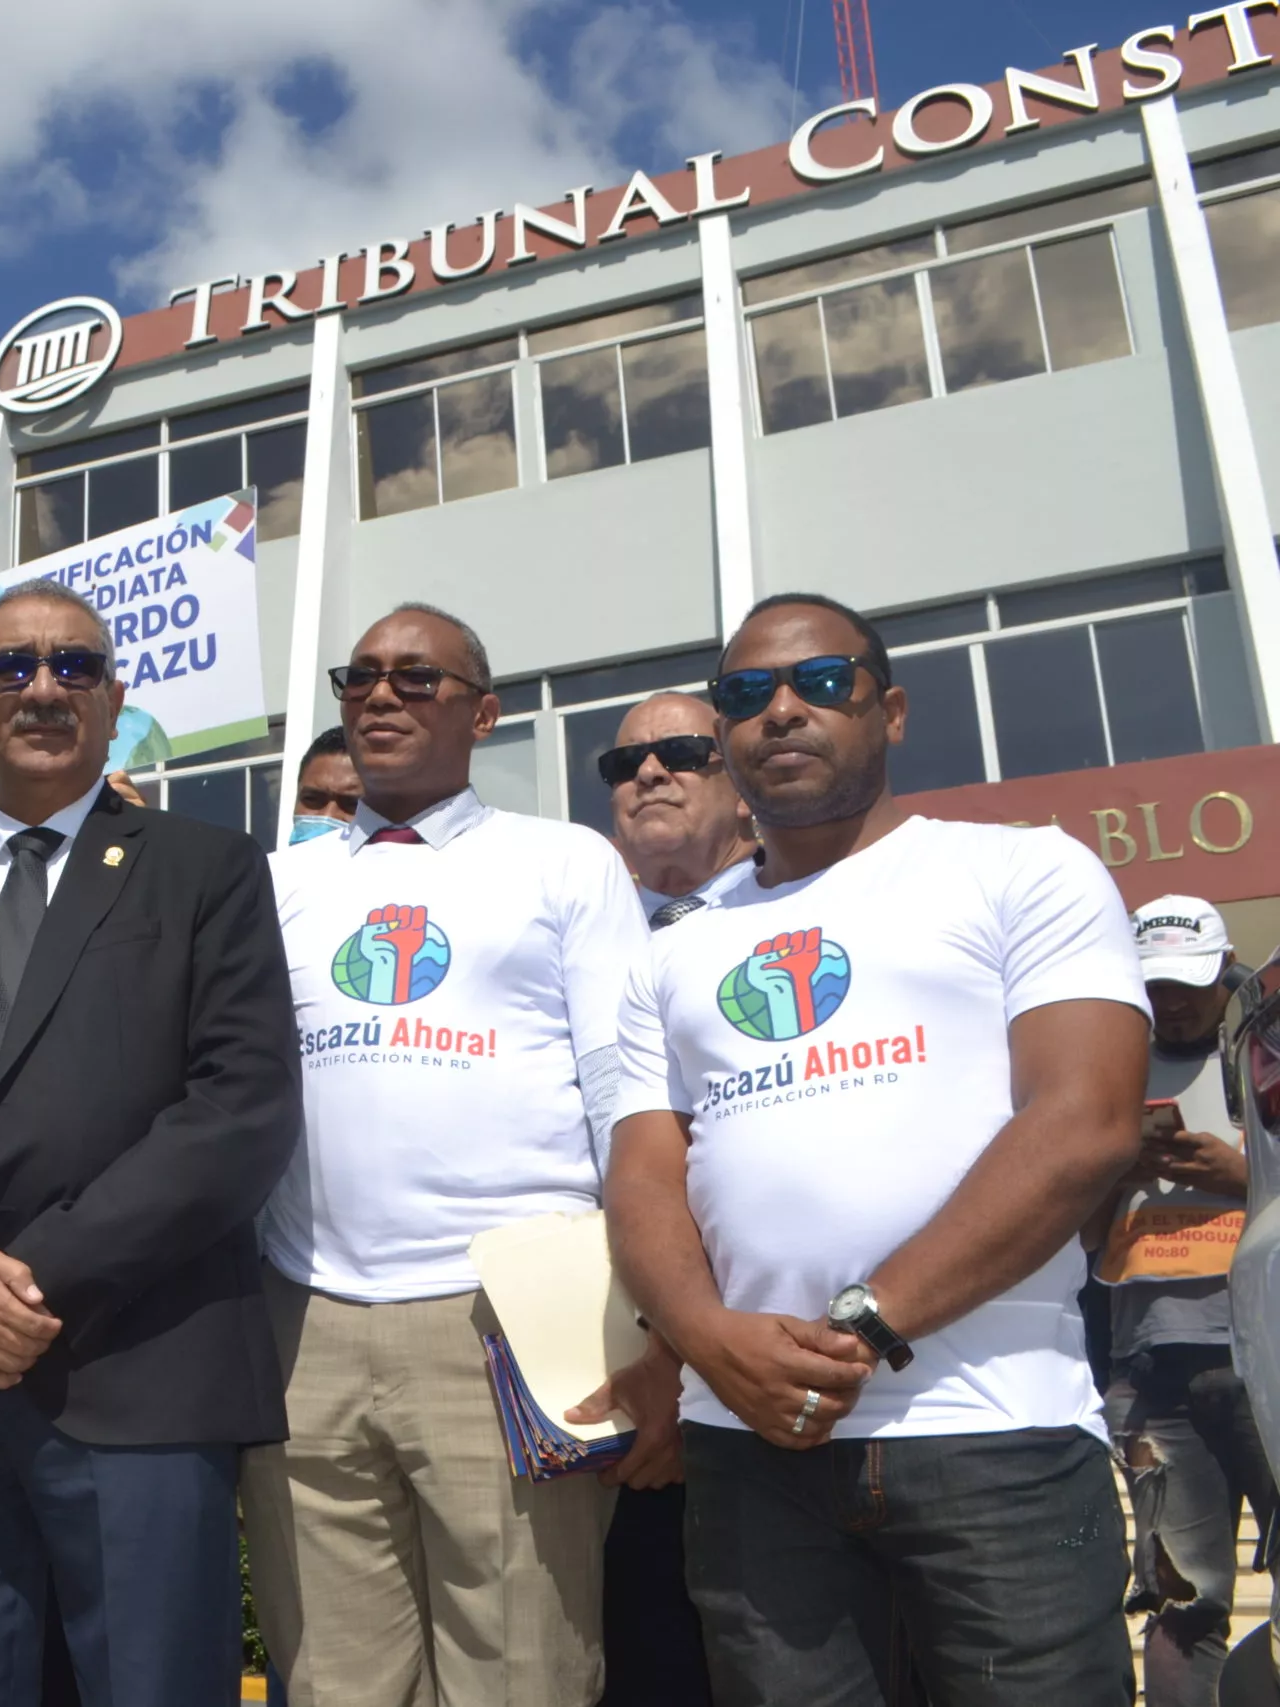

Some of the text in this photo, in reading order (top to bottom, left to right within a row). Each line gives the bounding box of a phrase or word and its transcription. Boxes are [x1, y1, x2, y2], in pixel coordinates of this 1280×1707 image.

[170, 0, 1279, 348] TRIBUNAL CONST
[40, 520, 212, 588] IFICACIÓN
[82, 562, 187, 611] DIATA
[115, 632, 217, 689] AZU
[1001, 791, 1253, 867] BLO
[308, 1052, 471, 1070] RATIFICACIÓN EN RD
[389, 1017, 496, 1058] Ahora!
[803, 1025, 927, 1081] Ahora!
[715, 1072, 898, 1121] RATIFICACIÓN EN RD
